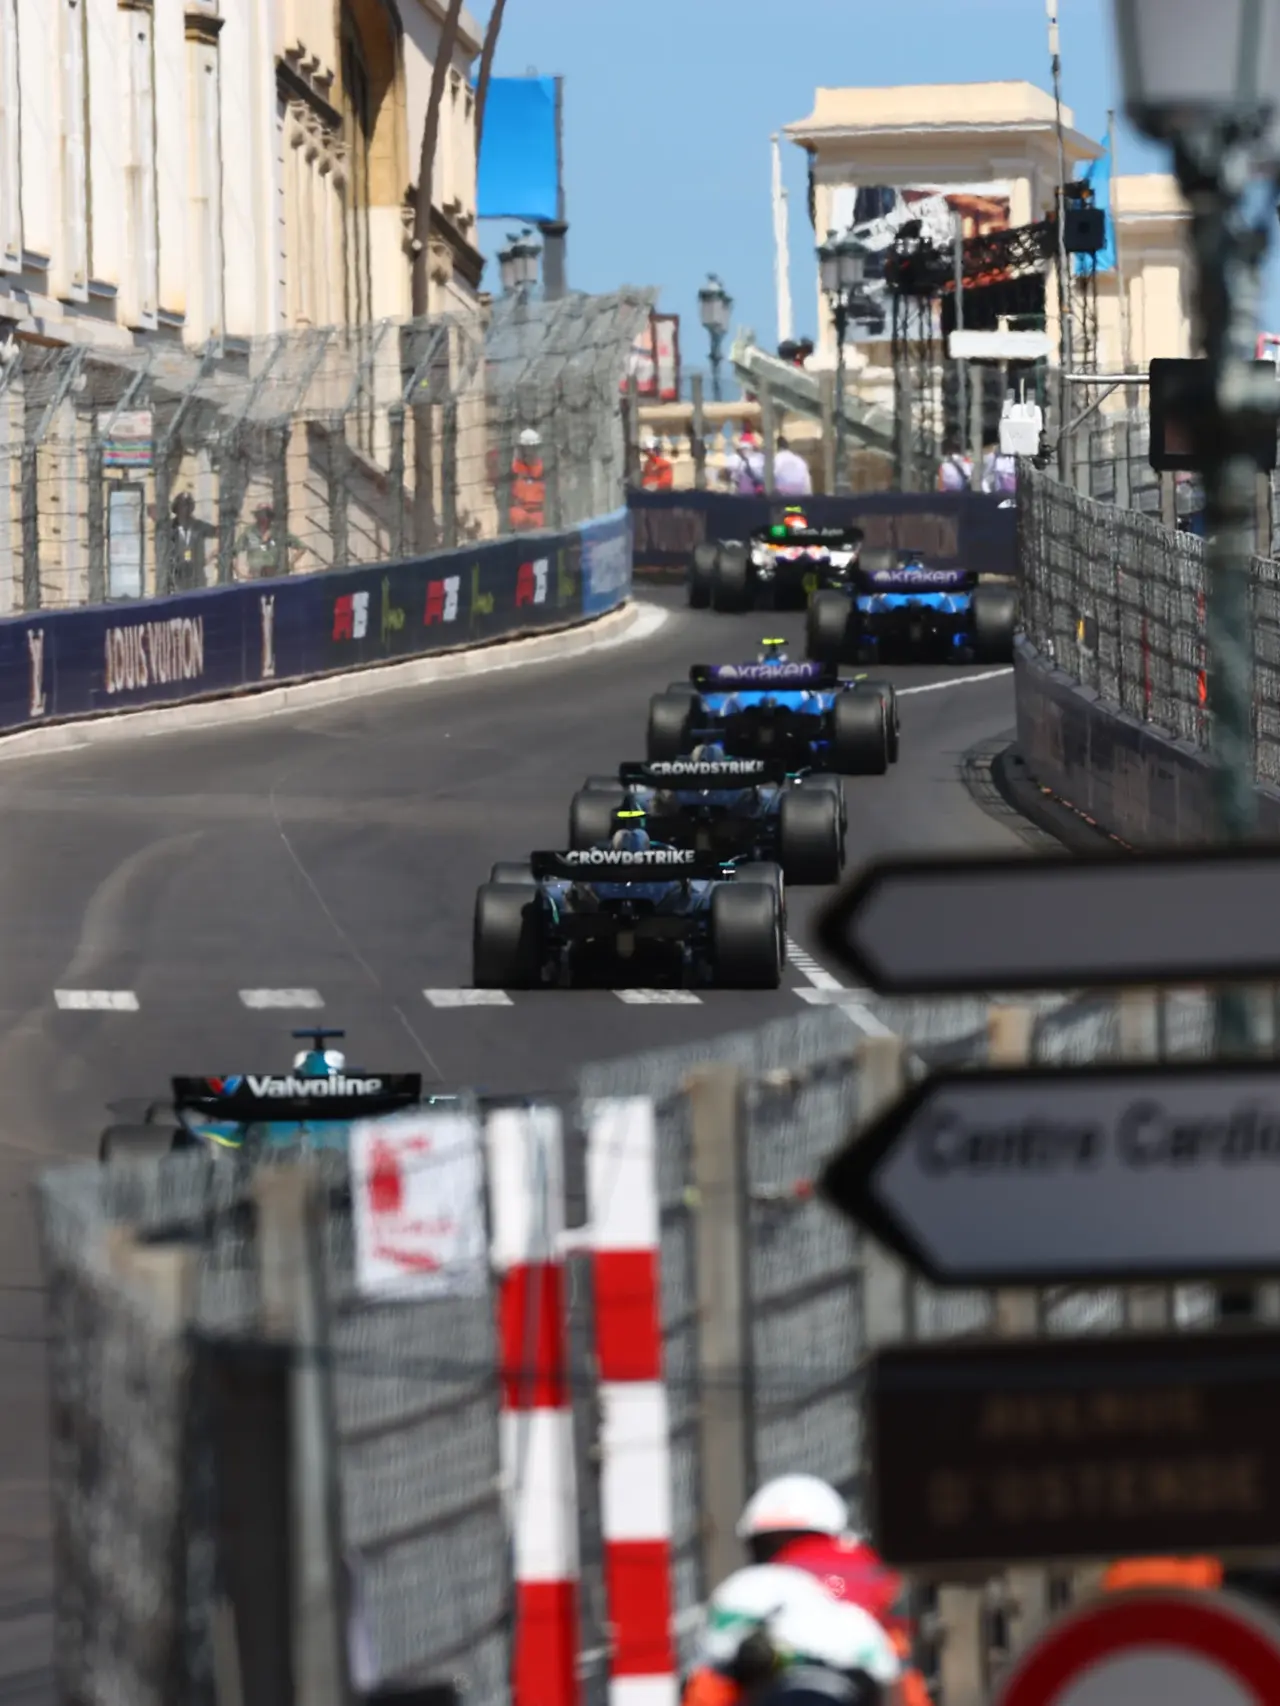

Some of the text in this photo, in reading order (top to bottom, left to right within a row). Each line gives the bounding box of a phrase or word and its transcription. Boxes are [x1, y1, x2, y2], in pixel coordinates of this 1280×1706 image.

[891, 569, 957, 583] kraken
[105, 615, 203, 694] LOUIS VUITTON
[737, 662, 813, 680] kraken
[650, 760, 765, 775] CROWDSTRIKE
[566, 849, 696, 865] CROWDSTRIKE
[246, 1073, 383, 1098] Valvoline
[915, 1106, 1102, 1179] Centre
